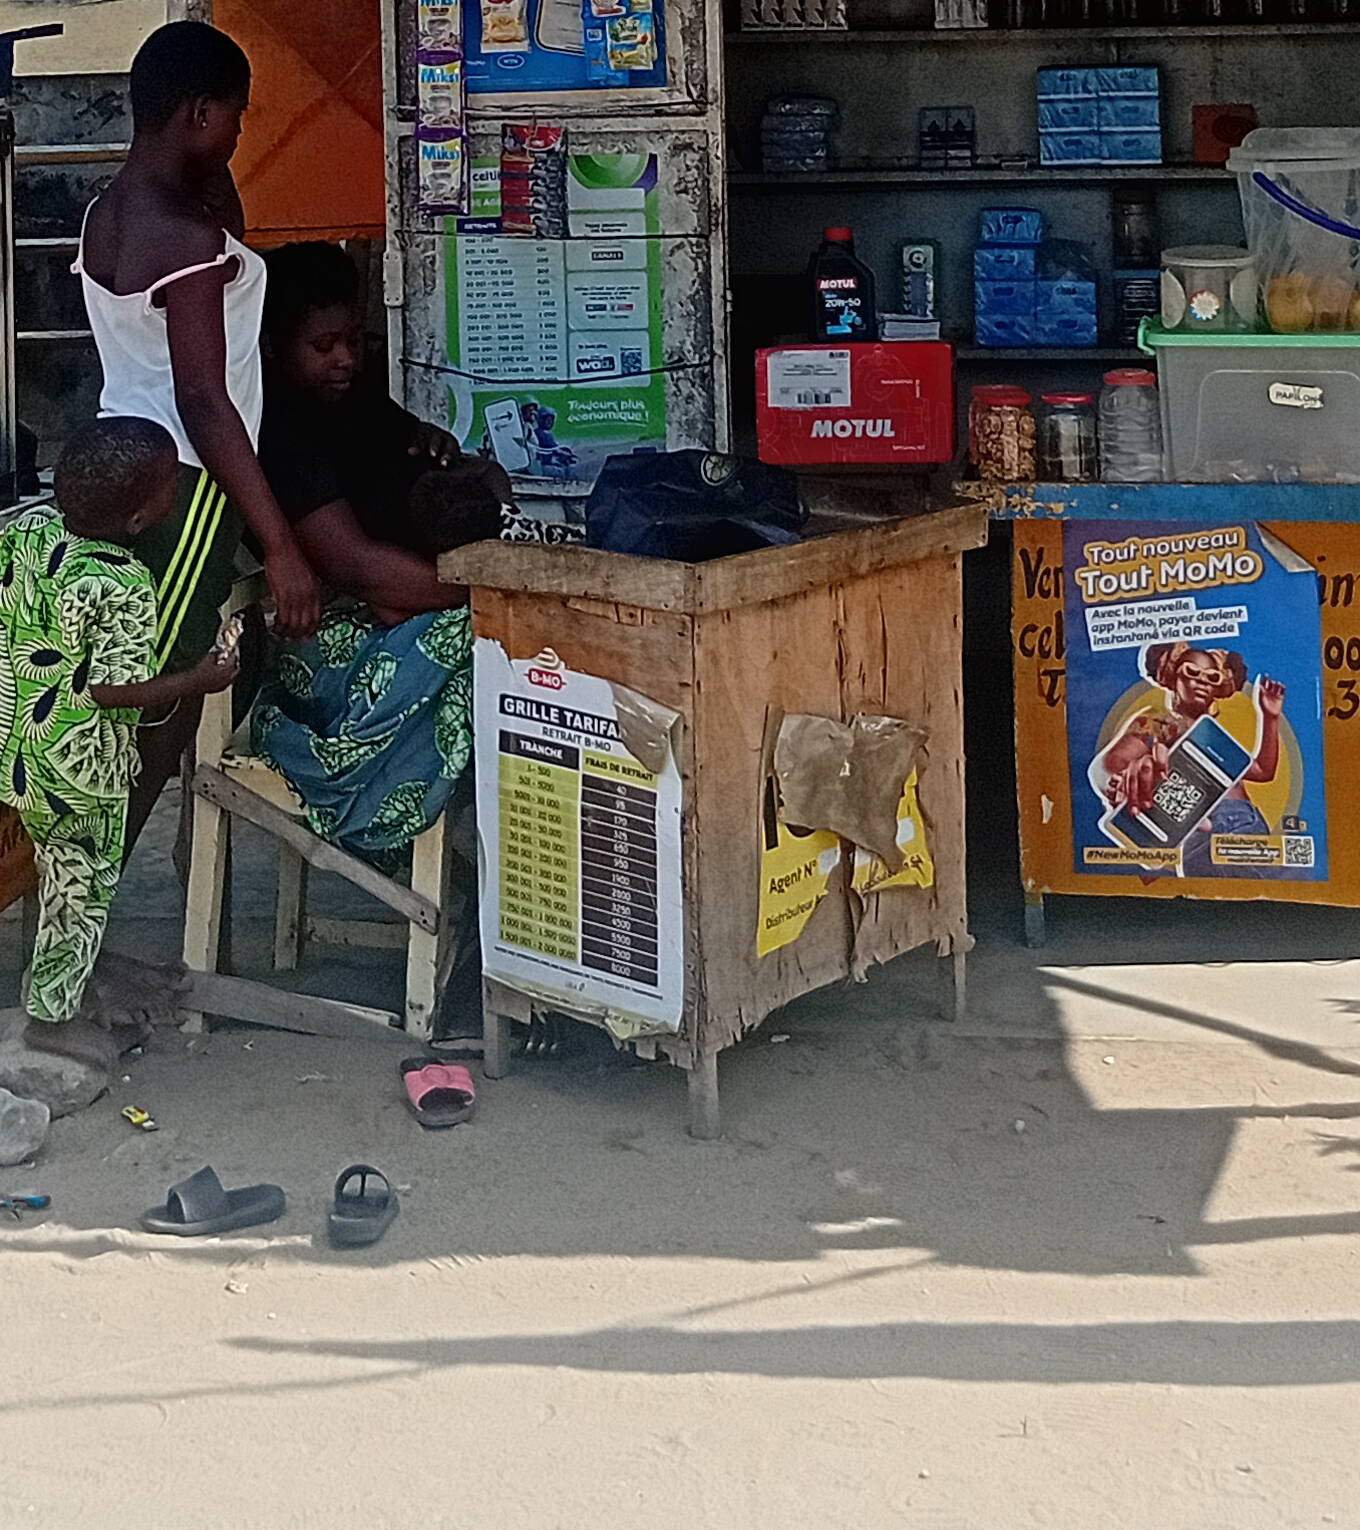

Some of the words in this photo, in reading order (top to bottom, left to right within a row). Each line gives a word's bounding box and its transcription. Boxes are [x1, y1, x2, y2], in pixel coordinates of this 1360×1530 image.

[819, 278, 856, 289] MOTUL
[811, 418, 895, 439] MOTUL
[1089, 542, 1139, 564] Tout
[1142, 532, 1238, 557] nouveau
[1080, 565, 1152, 596] Tout
[1160, 552, 1255, 585] MoMo
[1091, 622, 1115, 636] app
[1117, 616, 1157, 631] MoMo,
[1159, 613, 1195, 629] payer
[1196, 608, 1244, 622] devient
[1092, 607, 1122, 619] Avec
[1124, 605, 1135, 616] la
[1137, 600, 1190, 616] nouvelle
[1093, 628, 1160, 646] instantané
[1161, 625, 1180, 638] via
[1182, 624, 1202, 637] QR
[1204, 623, 1235, 635] code
[531, 670, 561, 688] B-MO
[504, 696, 560, 723] GRILLE
[564, 710, 623, 739] TARIFA
[520, 739, 563, 760] TRANCHE
[542, 726, 582, 745] RETRAIT
[584, 738, 611, 752] B-MO
[585, 757, 608, 770] FRAIS
[610, 763, 620, 774] DE
[622, 766, 653, 782] RETRAIT
[1086, 849, 1177, 863] #NewMoMoApp
[769, 866, 802, 895] Agent
[765, 897, 814, 930] Distributeur
